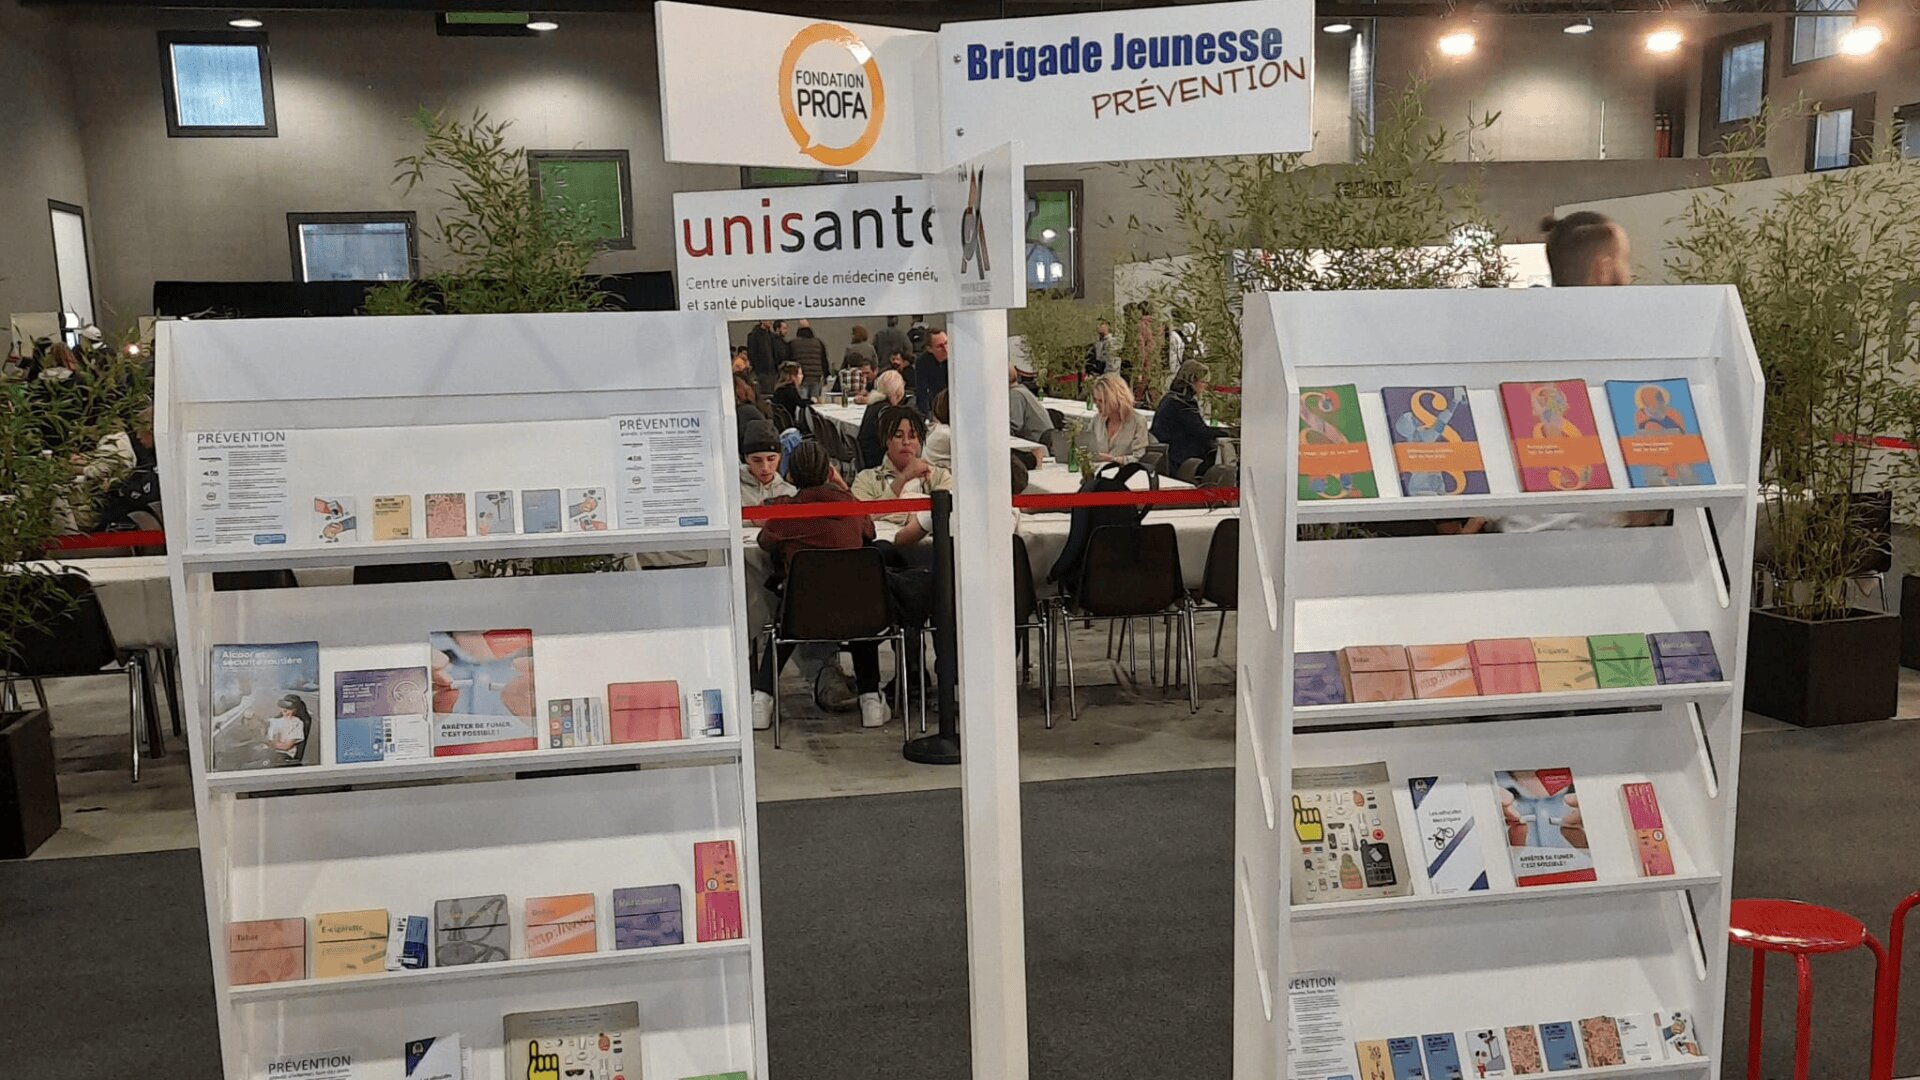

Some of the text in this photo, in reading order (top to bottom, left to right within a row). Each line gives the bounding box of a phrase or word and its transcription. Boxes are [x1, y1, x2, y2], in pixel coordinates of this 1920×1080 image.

[966, 27, 1282, 82] Brigade Jeunesse
[795, 70, 864, 88] FONDATION
[1092, 57, 1305, 119] PRÉVENTION
[797, 88, 867, 120] PROFA
[686, 268, 939, 290] Centre universitaire de médecine génér
[687, 298, 700, 311] et
[703, 296, 737, 310] santé
[741, 294, 795, 312] publique
[804, 295, 866, 308] Lausanne
[619, 417, 700, 431] PRÉVENTION
[196, 431, 286, 444] PRÉVENTION
[268, 1055, 352, 1074] PRÉVENTION
